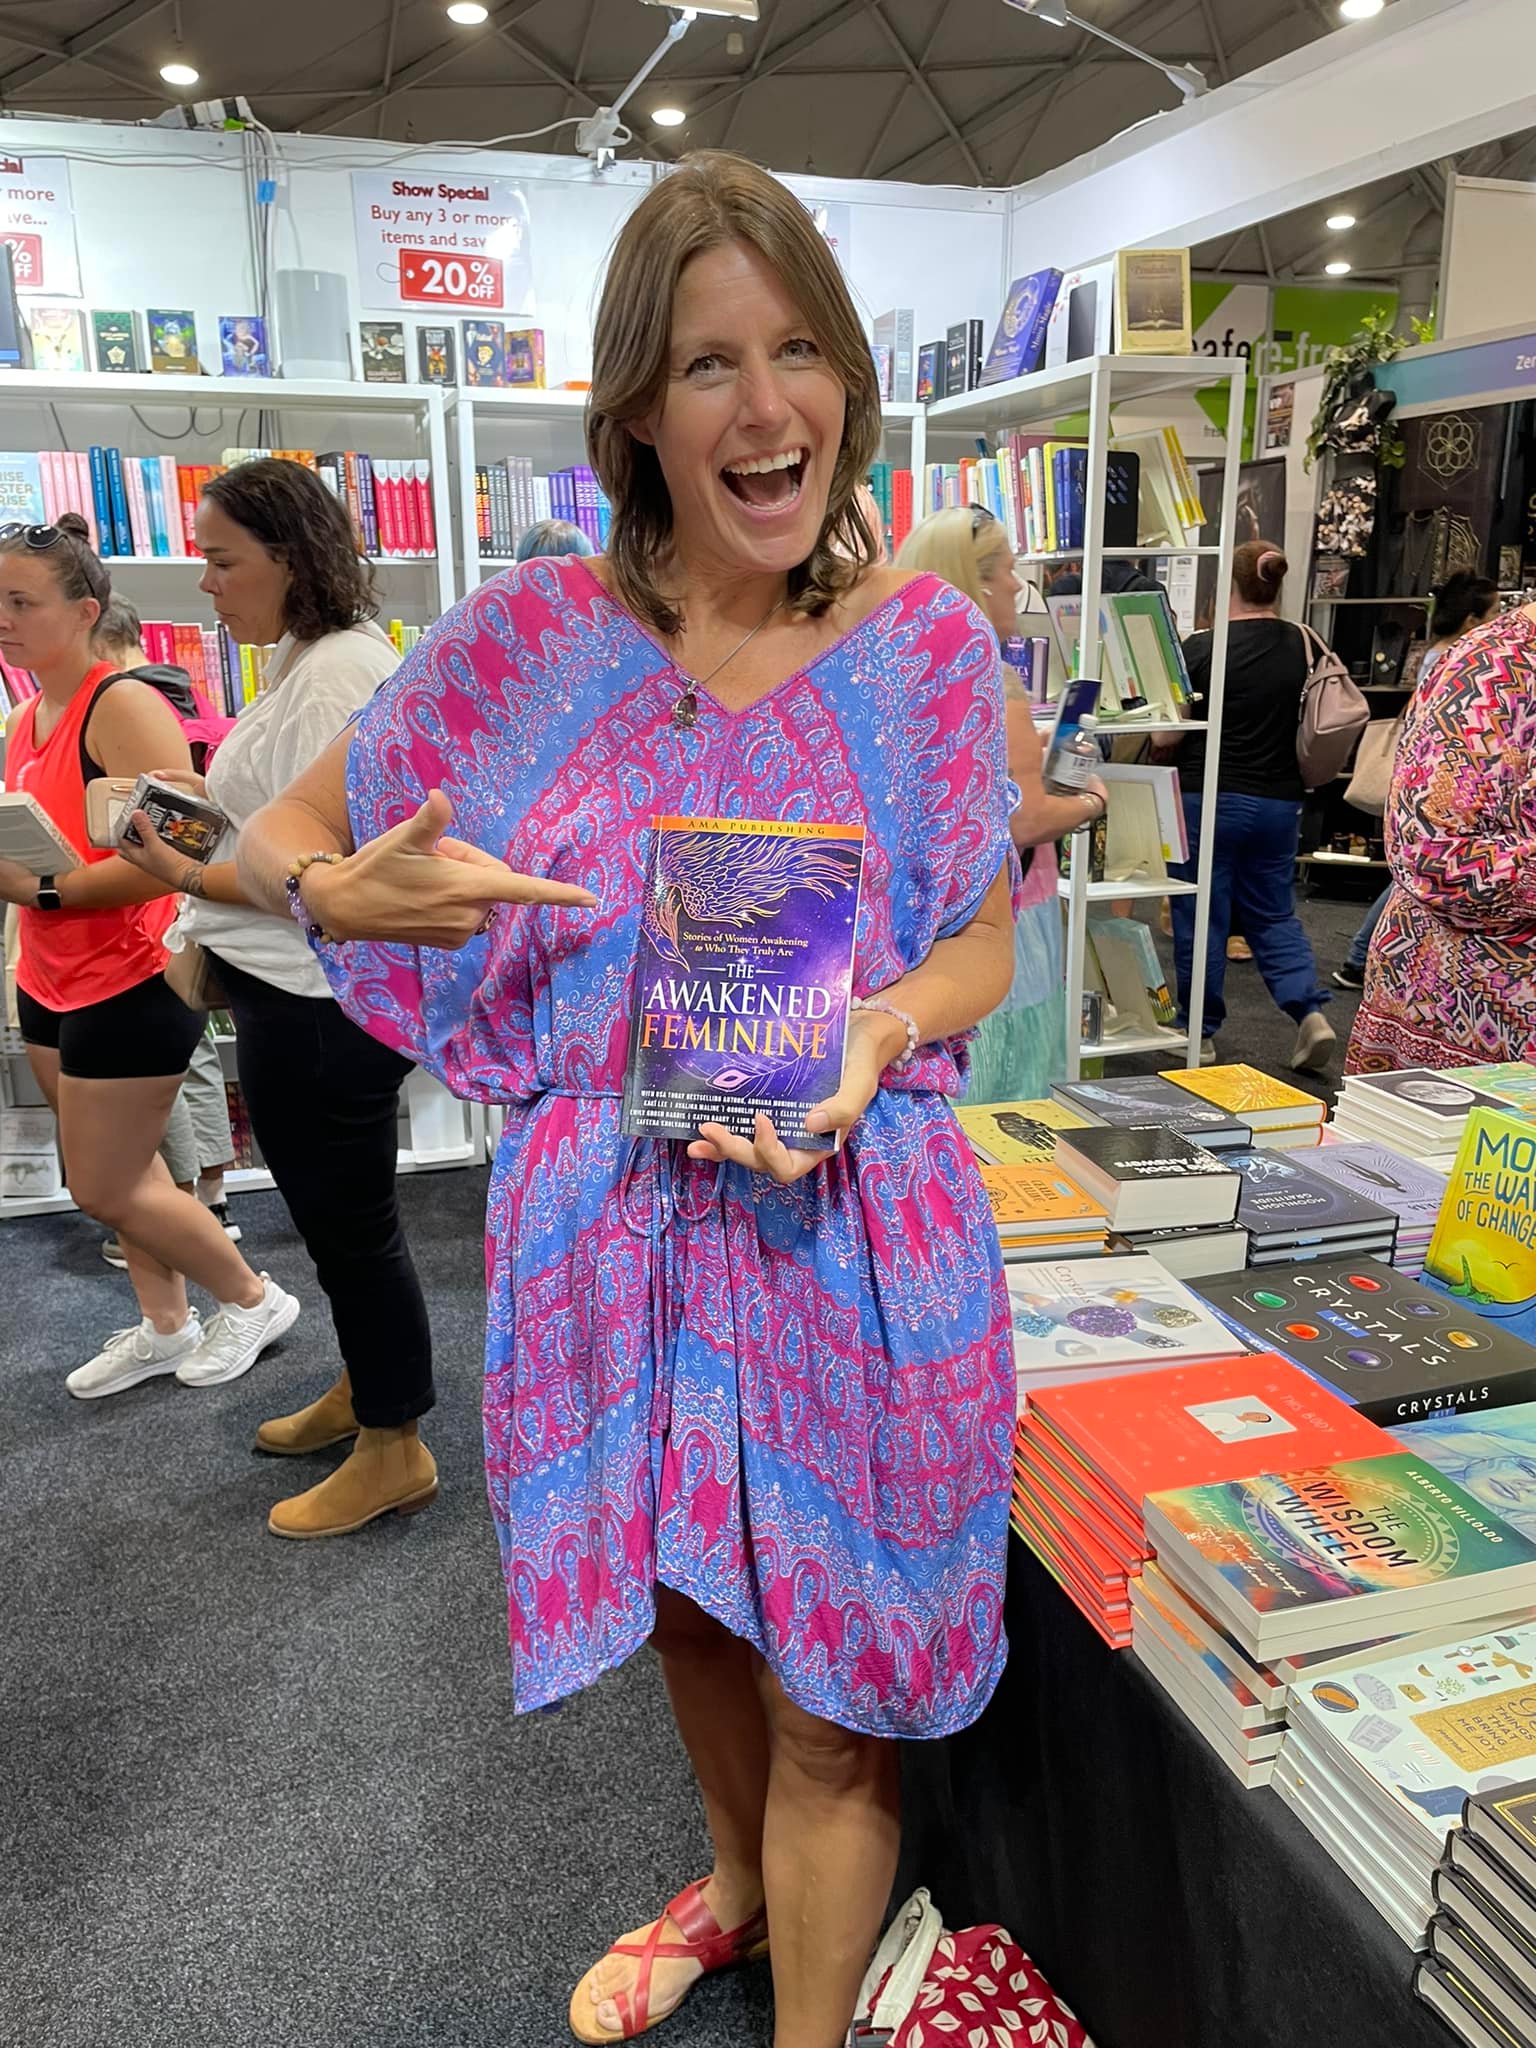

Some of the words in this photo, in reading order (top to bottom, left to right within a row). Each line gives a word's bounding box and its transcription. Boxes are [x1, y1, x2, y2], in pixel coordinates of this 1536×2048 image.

[8, 188, 55, 201] more
[392, 181, 434, 197] Show
[438, 184, 489, 203] Special
[371, 205, 401, 224] Buy
[406, 211, 432, 226] any
[438, 208, 447, 223] 3
[452, 213, 470, 223] or
[475, 214, 516, 227] mor
[381, 229, 424, 245] items
[430, 232, 457, 246] and
[463, 236, 487, 248] sav
[15, 262, 33, 278] FF
[421, 259, 495, 297] 20%
[468, 283, 495, 299] OFF
[0, 471, 24, 482] ISE
[688, 821, 719, 830] AMA
[730, 822, 826, 835] PUBLISHING
[683, 931, 711, 942] Stories
[713, 932, 724, 942] of
[724, 934, 758, 944] Women
[760, 936, 809, 947] Awakening
[695, 944, 703, 952] to
[703, 943, 726, 953] Who
[728, 944, 750, 956] They
[752, 946, 776, 957] Truly
[777, 947, 794, 957] Are
[726, 963, 755, 979] THE
[644, 979, 832, 1019] AWAKENED
[641, 1013, 828, 1059] FEMININE
[687, 1093, 722, 1102] BESTSELLING
[1475, 1127, 1536, 1173] MO
[1114, 1157, 1188, 1168] Answers
[1137, 1166, 1187, 1174] Book
[1250, 1192, 1313, 1205] GRATITUDE
[1464, 1172, 1492, 1190] THE
[1495, 1172, 1536, 1211] WA
[1257, 1197, 1327, 1211] MOONLIGHT
[1457, 1199, 1474, 1222] OF
[1476, 1202, 1536, 1250] CHANGE
[1292, 1276, 1448, 1367] CRYSTALS
[1327, 1315, 1358, 1333] KIT
[1396, 1385, 1490, 1417] CRYSTALS
[1368, 1504, 1410, 1531] THE
[1405, 1470, 1451, 1505] ALBERTO
[1451, 1503, 1503, 1543] VILLOLDO
[1276, 1494, 1369, 1568] WHEEL
[1302, 1481, 1418, 1568] WISDOM
[1472, 1715, 1507, 1746] BRING
[1487, 1714, 1520, 1740] THAT
[1496, 1705, 1536, 1740] THINGS
[1435, 1729, 1467, 1754] journal
[1457, 1718, 1476, 1733] ME
[1472, 1735, 1499, 1752] JOY
